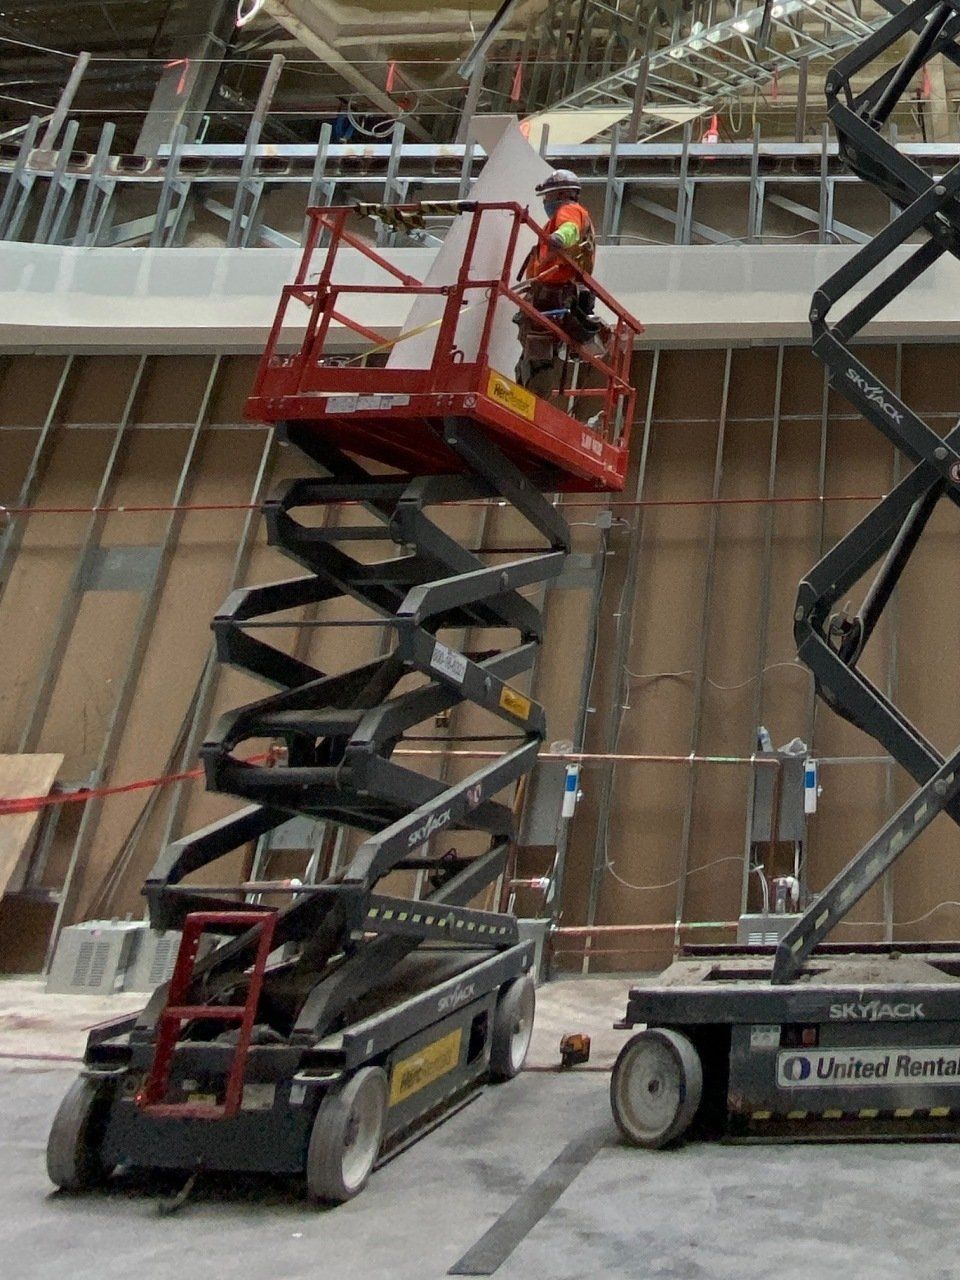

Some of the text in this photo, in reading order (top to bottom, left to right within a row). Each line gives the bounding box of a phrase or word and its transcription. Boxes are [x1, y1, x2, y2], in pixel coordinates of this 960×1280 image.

[845, 368, 904, 425] SKYJACK
[408, 808, 451, 847] SKYJACK
[437, 982, 476, 1013] SKYJACK
[829, 1000, 925, 1022] SKYJACK
[816, 1055, 889, 1080] United
